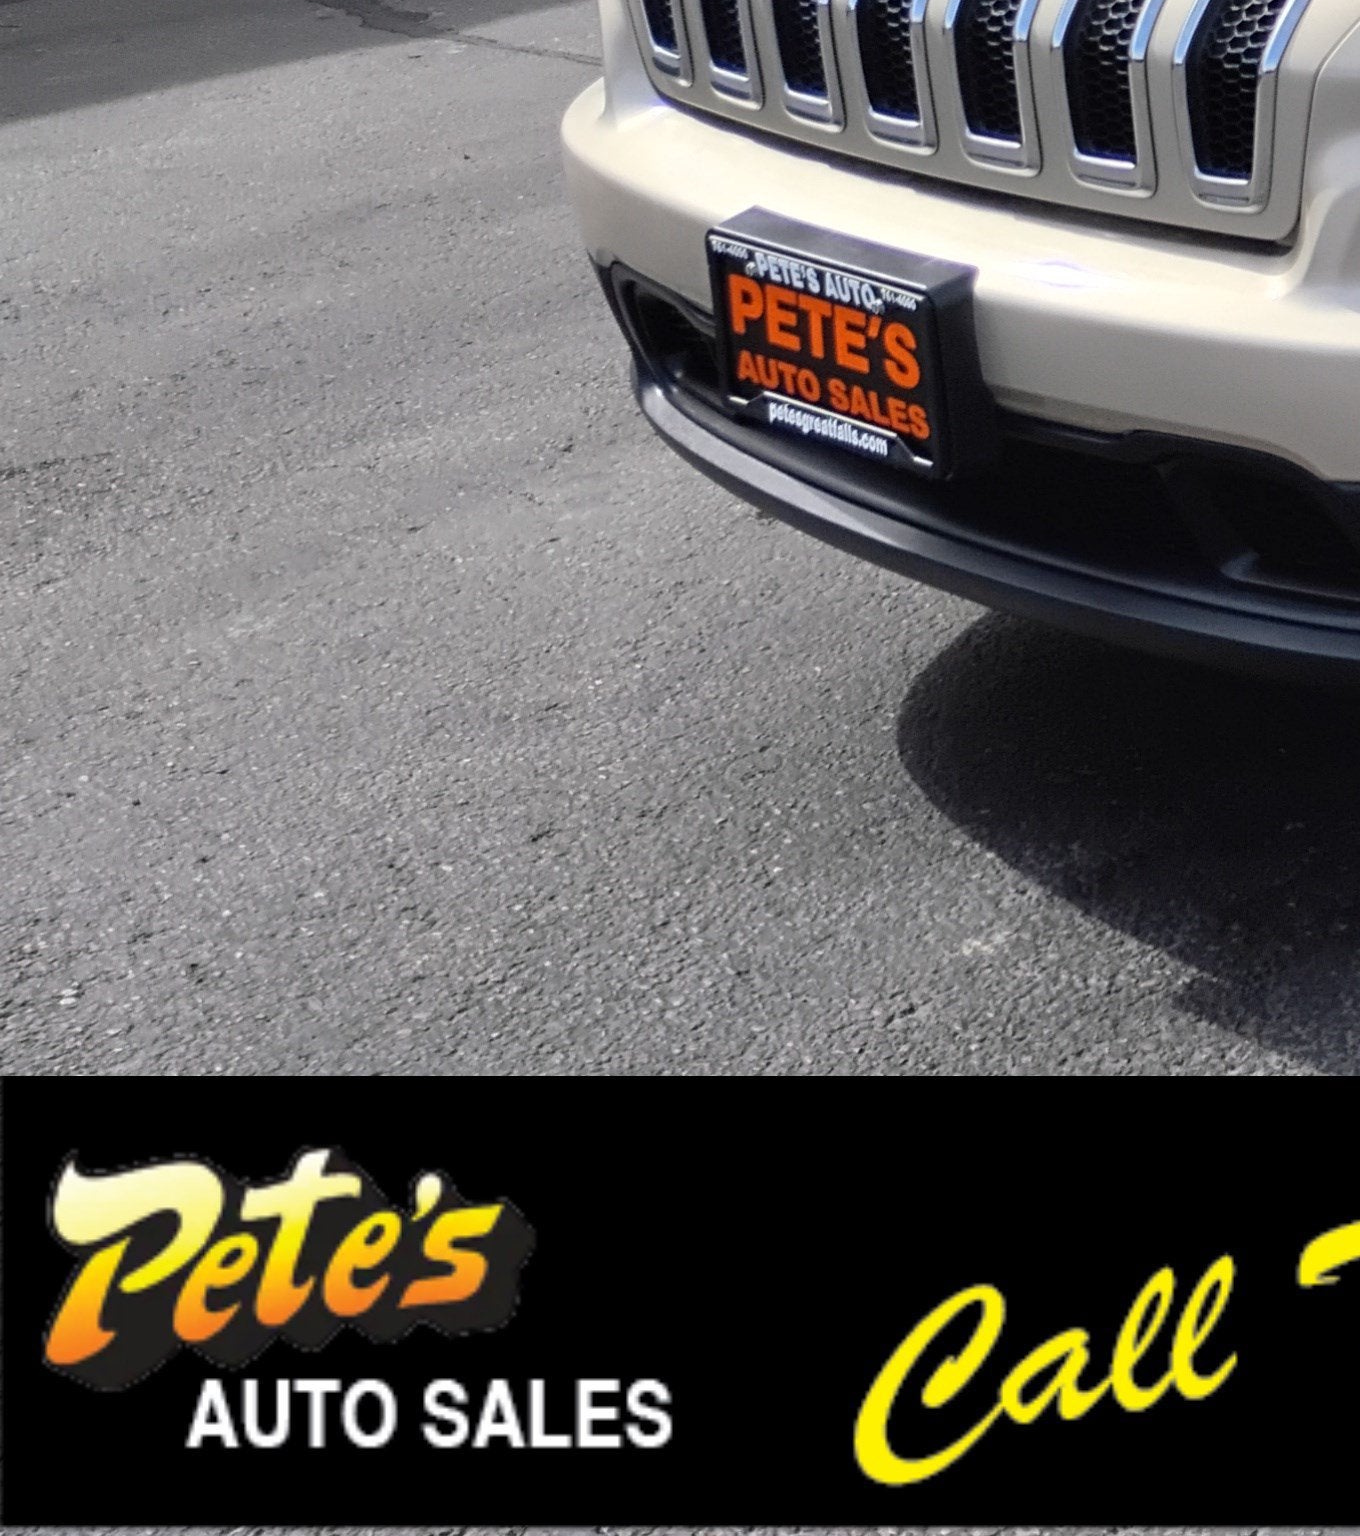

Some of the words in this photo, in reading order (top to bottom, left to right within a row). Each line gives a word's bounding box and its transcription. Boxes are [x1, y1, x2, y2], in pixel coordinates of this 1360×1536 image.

[755, 252, 821, 294] PETE'S
[824, 271, 877, 308] AUTO
[727, 273, 921, 390] PETE'S
[737, 350, 821, 402] AUTO
[828, 378, 931, 441] SALES
[768, 401, 889, 457] petesgreatfalls.com
